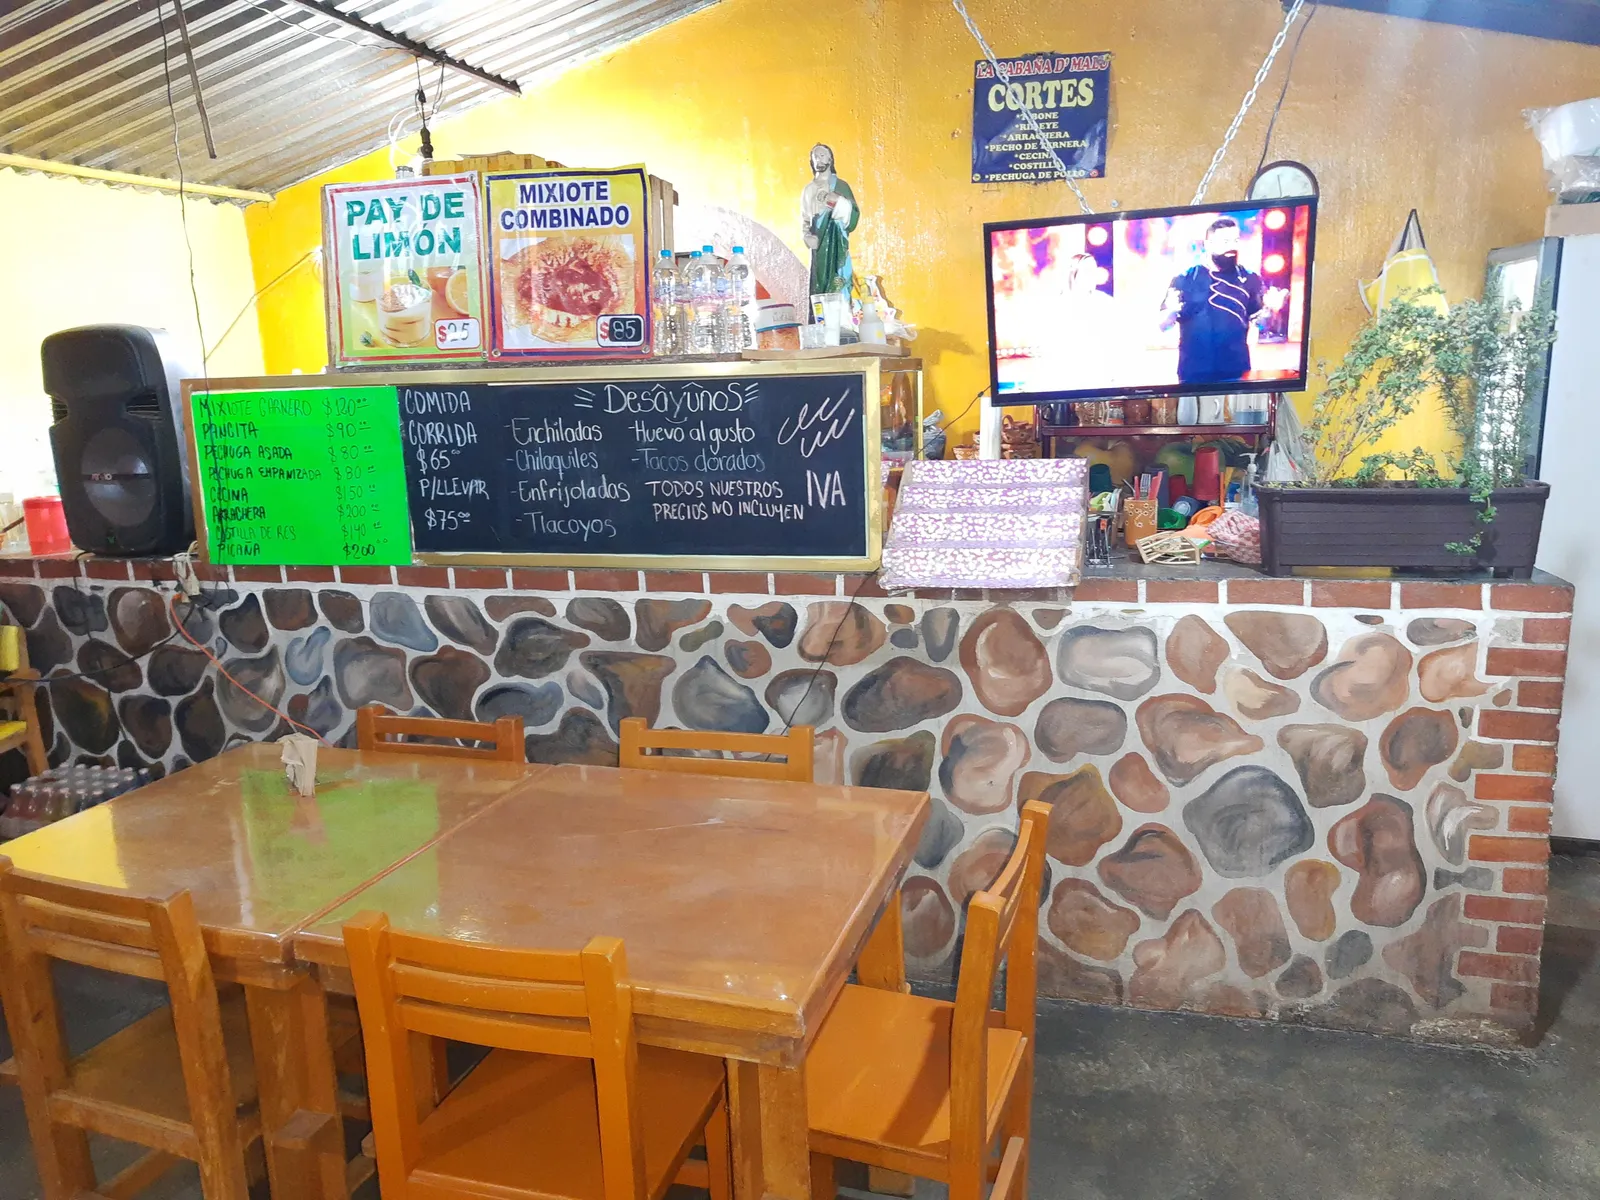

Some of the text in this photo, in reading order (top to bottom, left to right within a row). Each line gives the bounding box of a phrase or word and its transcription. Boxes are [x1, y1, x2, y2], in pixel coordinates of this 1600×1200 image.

[976, 62, 994, 79] LA
[988, 78, 1094, 112] CORTES
[989, 143, 1022, 152] PECHO
[1024, 142, 1038, 151] DE
[989, 171, 1036, 181] PECHUGA
[1038, 171, 1052, 179] DE
[519, 181, 609, 205] MIXIOTE
[346, 191, 466, 226] PAY DE
[500, 205, 630, 230] COMBINADO
[352, 222, 462, 260] LIMÓN
[199, 398, 252, 418] MIXIOTE
[259, 397, 313, 418] CARNERO
[405, 389, 472, 415] COMIDA
[202, 421, 259, 440] PANCITA
[408, 419, 478, 447] CORRIDA
[689, 420, 706, 443] al
[709, 418, 756, 455] gusto
[205, 444, 251, 460] PECHUGA
[258, 445, 293, 460] ASADA
[694, 448, 765, 473] dorados
[645, 481, 784, 500] TODOS NUESTROS
[805, 469, 847, 509] IVA
[652, 500, 805, 523] PRECIOS NO INCLUYEN
[260, 526, 273, 540] DE
[216, 540, 261, 558] PICAÑA
